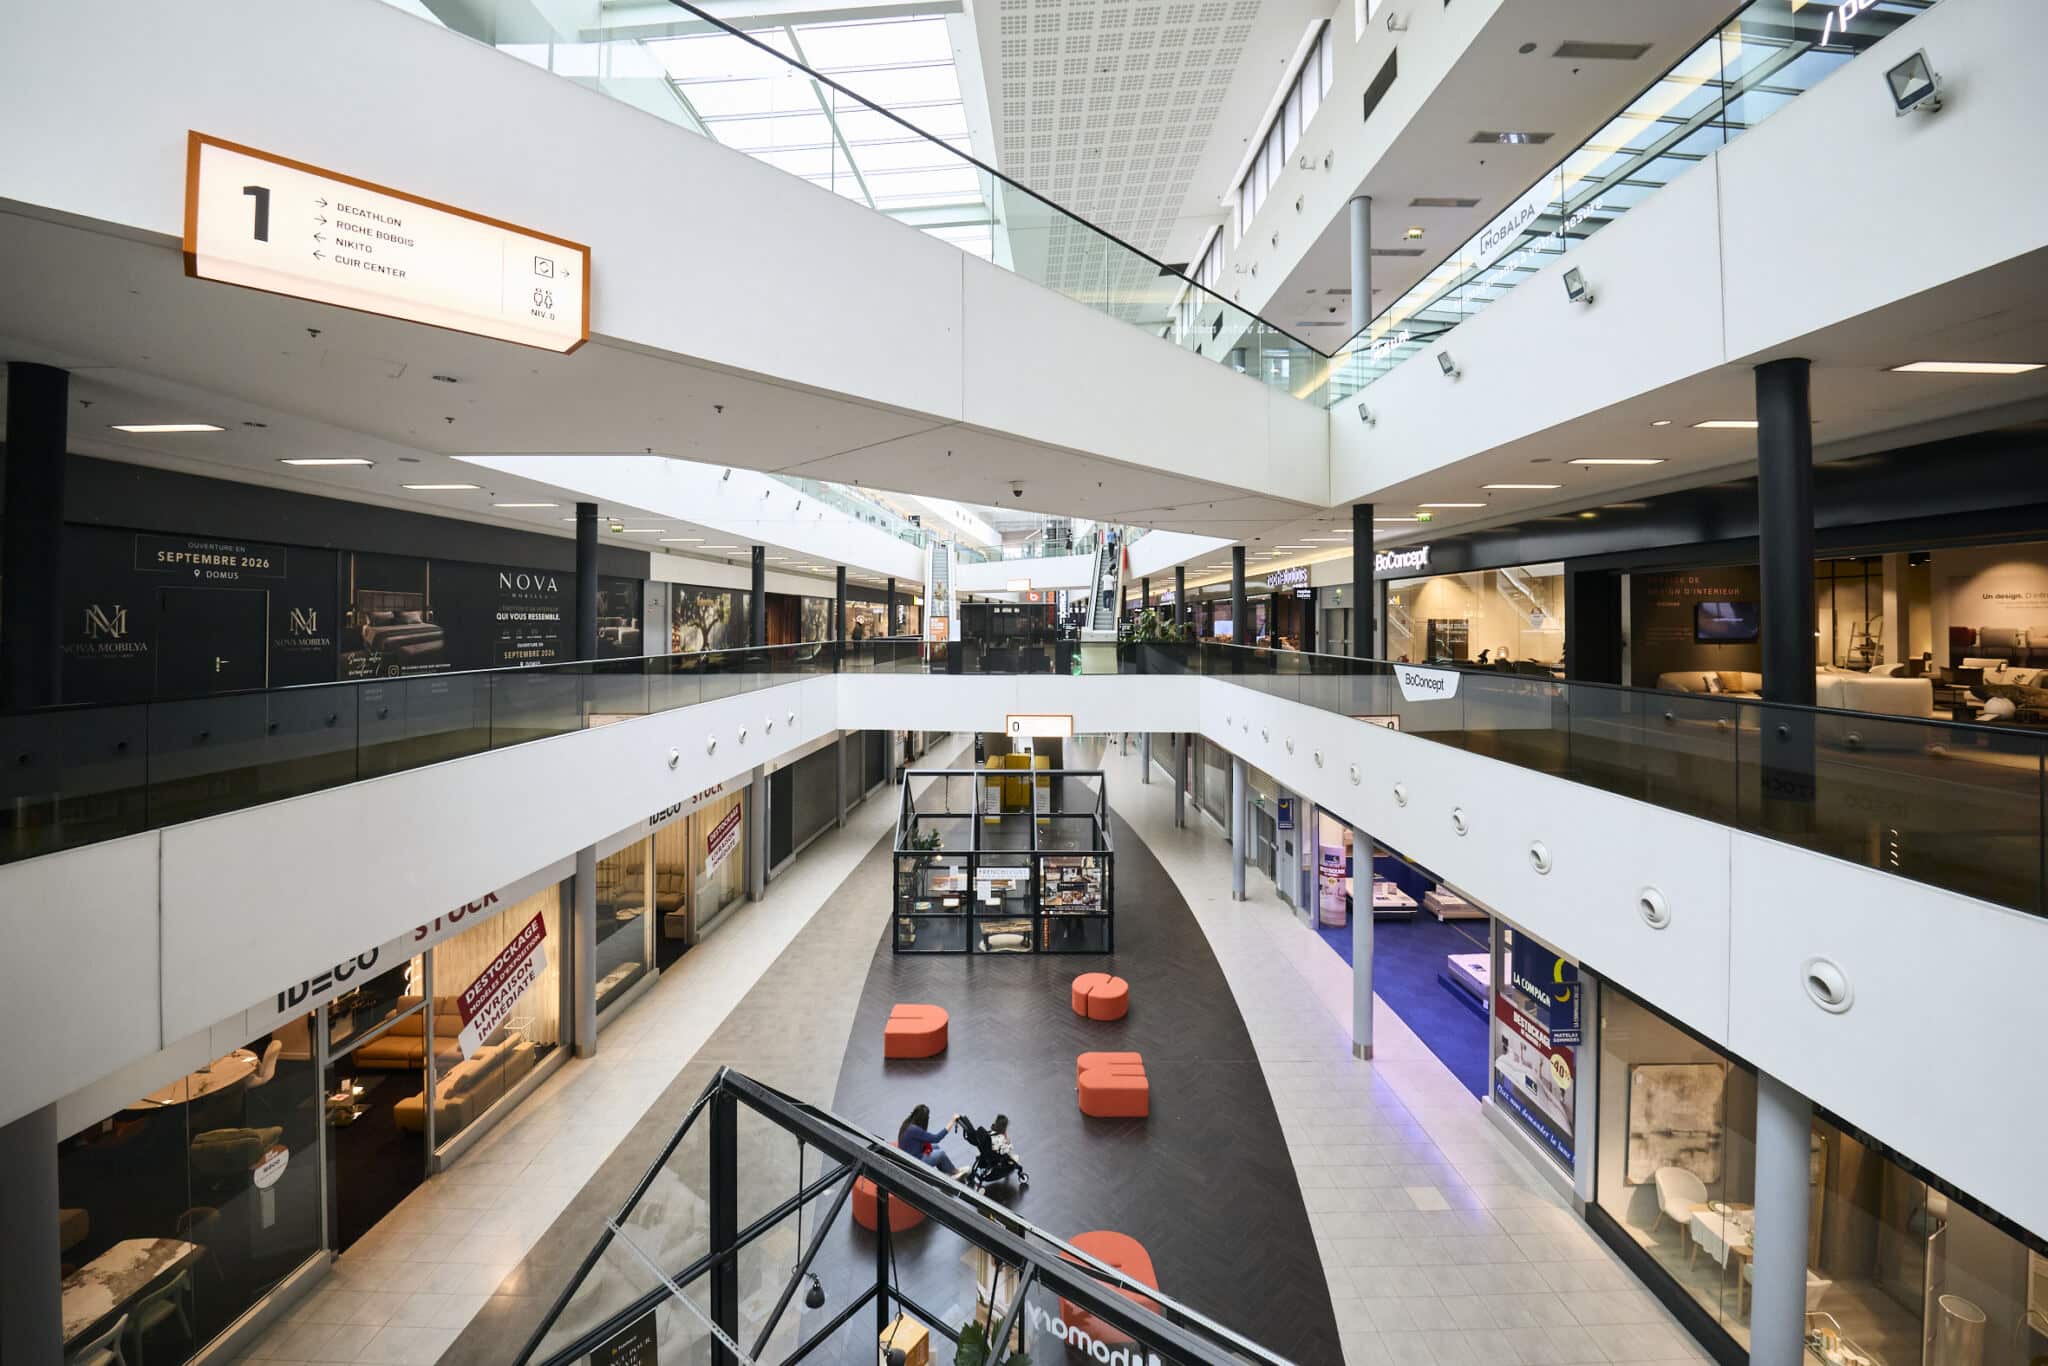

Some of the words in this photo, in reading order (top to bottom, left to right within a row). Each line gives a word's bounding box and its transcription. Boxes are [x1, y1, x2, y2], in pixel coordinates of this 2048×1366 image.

[242, 185, 271, 243] 1
[336, 202, 403, 228] DECATHLON
[336, 219, 374, 237] ROCHE
[376, 229, 415, 248] BOBOIS
[1484, 203, 1536, 250] MOBALPA
[335, 237, 373, 254] NIKITO
[335, 254, 362, 269] CUIR
[363, 261, 407, 279] CENTER
[157, 551, 238, 567] SEPTEMBRE
[240, 556, 270, 569] 2026
[1375, 546, 1430, 571] BoConcept
[206, 570, 240, 580] DOMUS
[499, 571, 559, 593] NOVA
[510, 612, 527, 621] VOUS
[504, 650, 540, 660] SEPTEMBRE
[1405, 673, 1445, 693] BoConcept
[464, 919, 540, 1005] DESTOCKAGE
[1513, 971, 1521, 986] LA
[473, 957, 534, 1031] LIVRAISON
